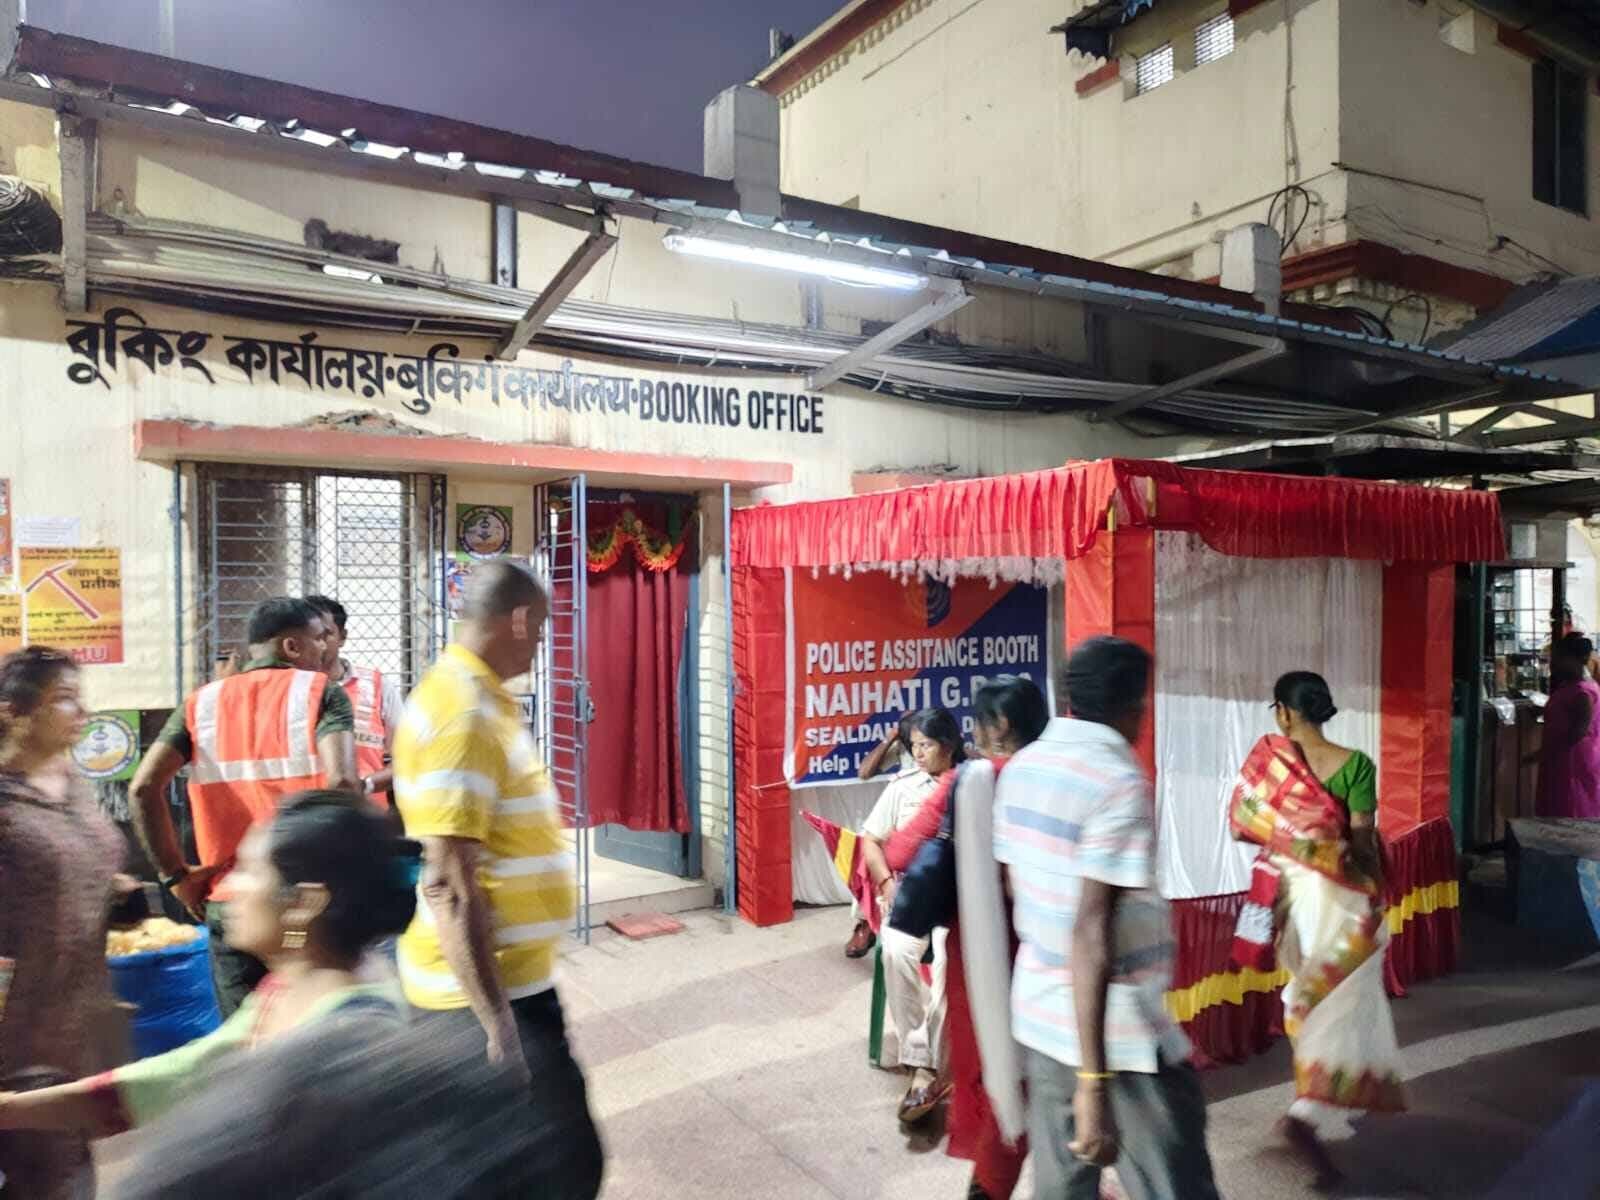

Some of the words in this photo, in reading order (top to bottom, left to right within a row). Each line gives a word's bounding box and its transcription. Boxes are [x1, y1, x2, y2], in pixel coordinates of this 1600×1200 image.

[65, 307, 216, 390] বুকিং
[222, 331, 388, 398] কার্যালয়
[639, 379, 741, 427] BOOKING
[747, 390, 824, 434] OFFICE
[805, 640, 876, 675] POLICE
[881, 636, 979, 671] ASSITANCE
[983, 634, 1039, 665] BOOTH
[804, 677, 931, 718] NAIHATI
[808, 755, 850, 776] Help
